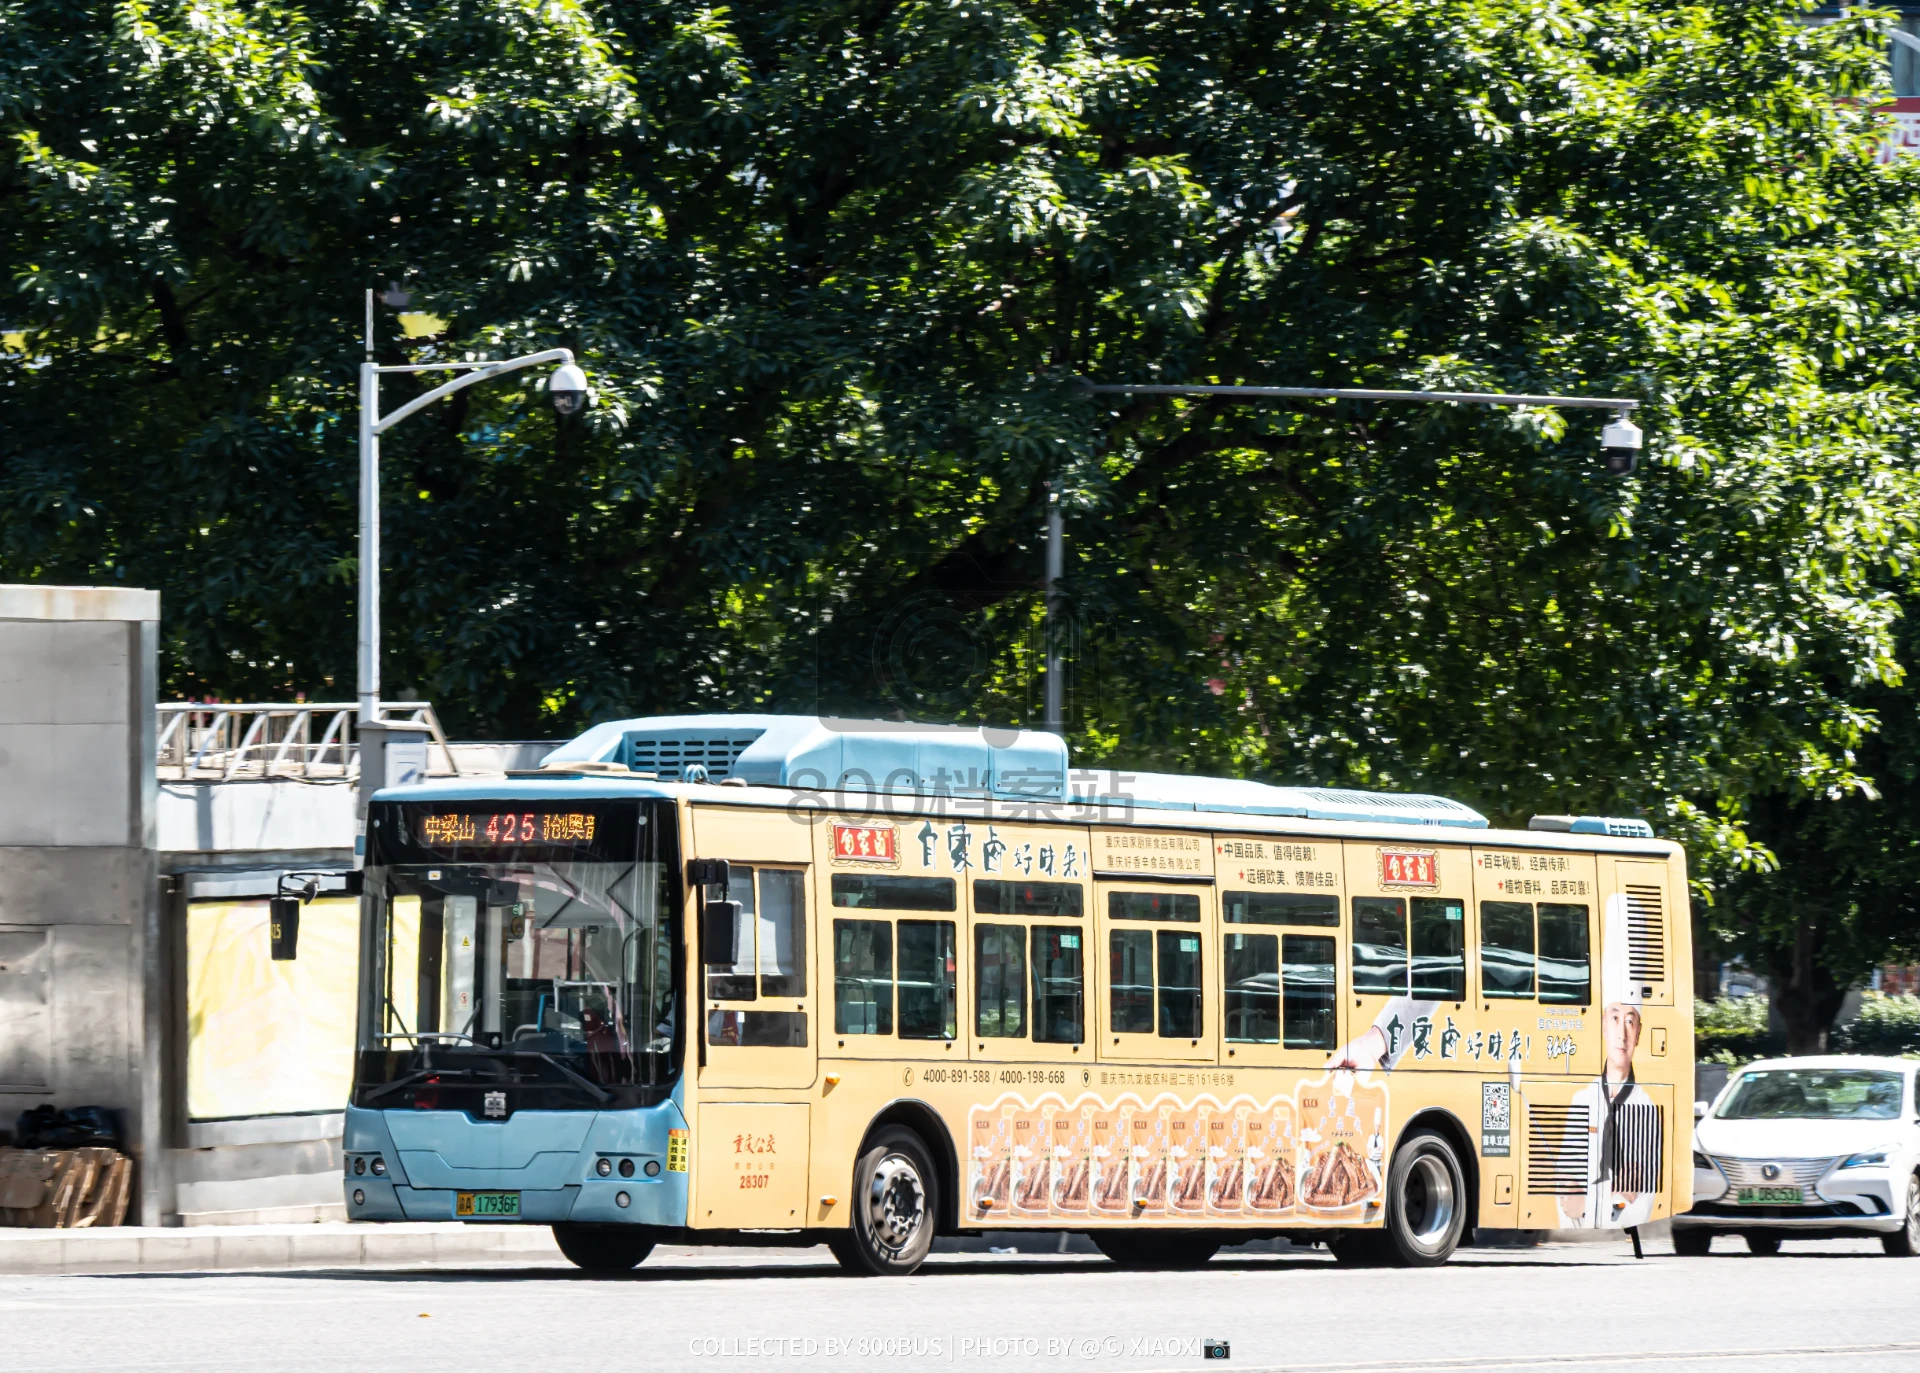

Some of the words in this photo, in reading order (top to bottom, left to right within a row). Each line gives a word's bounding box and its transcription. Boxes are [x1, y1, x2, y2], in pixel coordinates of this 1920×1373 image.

[425, 814, 476, 842] 中梁山
[486, 813, 536, 842] 425
[271, 924, 281, 939] 25
[923, 1069, 990, 1084] 4000-891-588
[999, 1070, 1066, 1085] 4000-198-668
[732, 1133, 777, 1155] 重庆公交
[739, 1174, 769, 1190] 28307
[477, 1196, 518, 1213] 17936F
